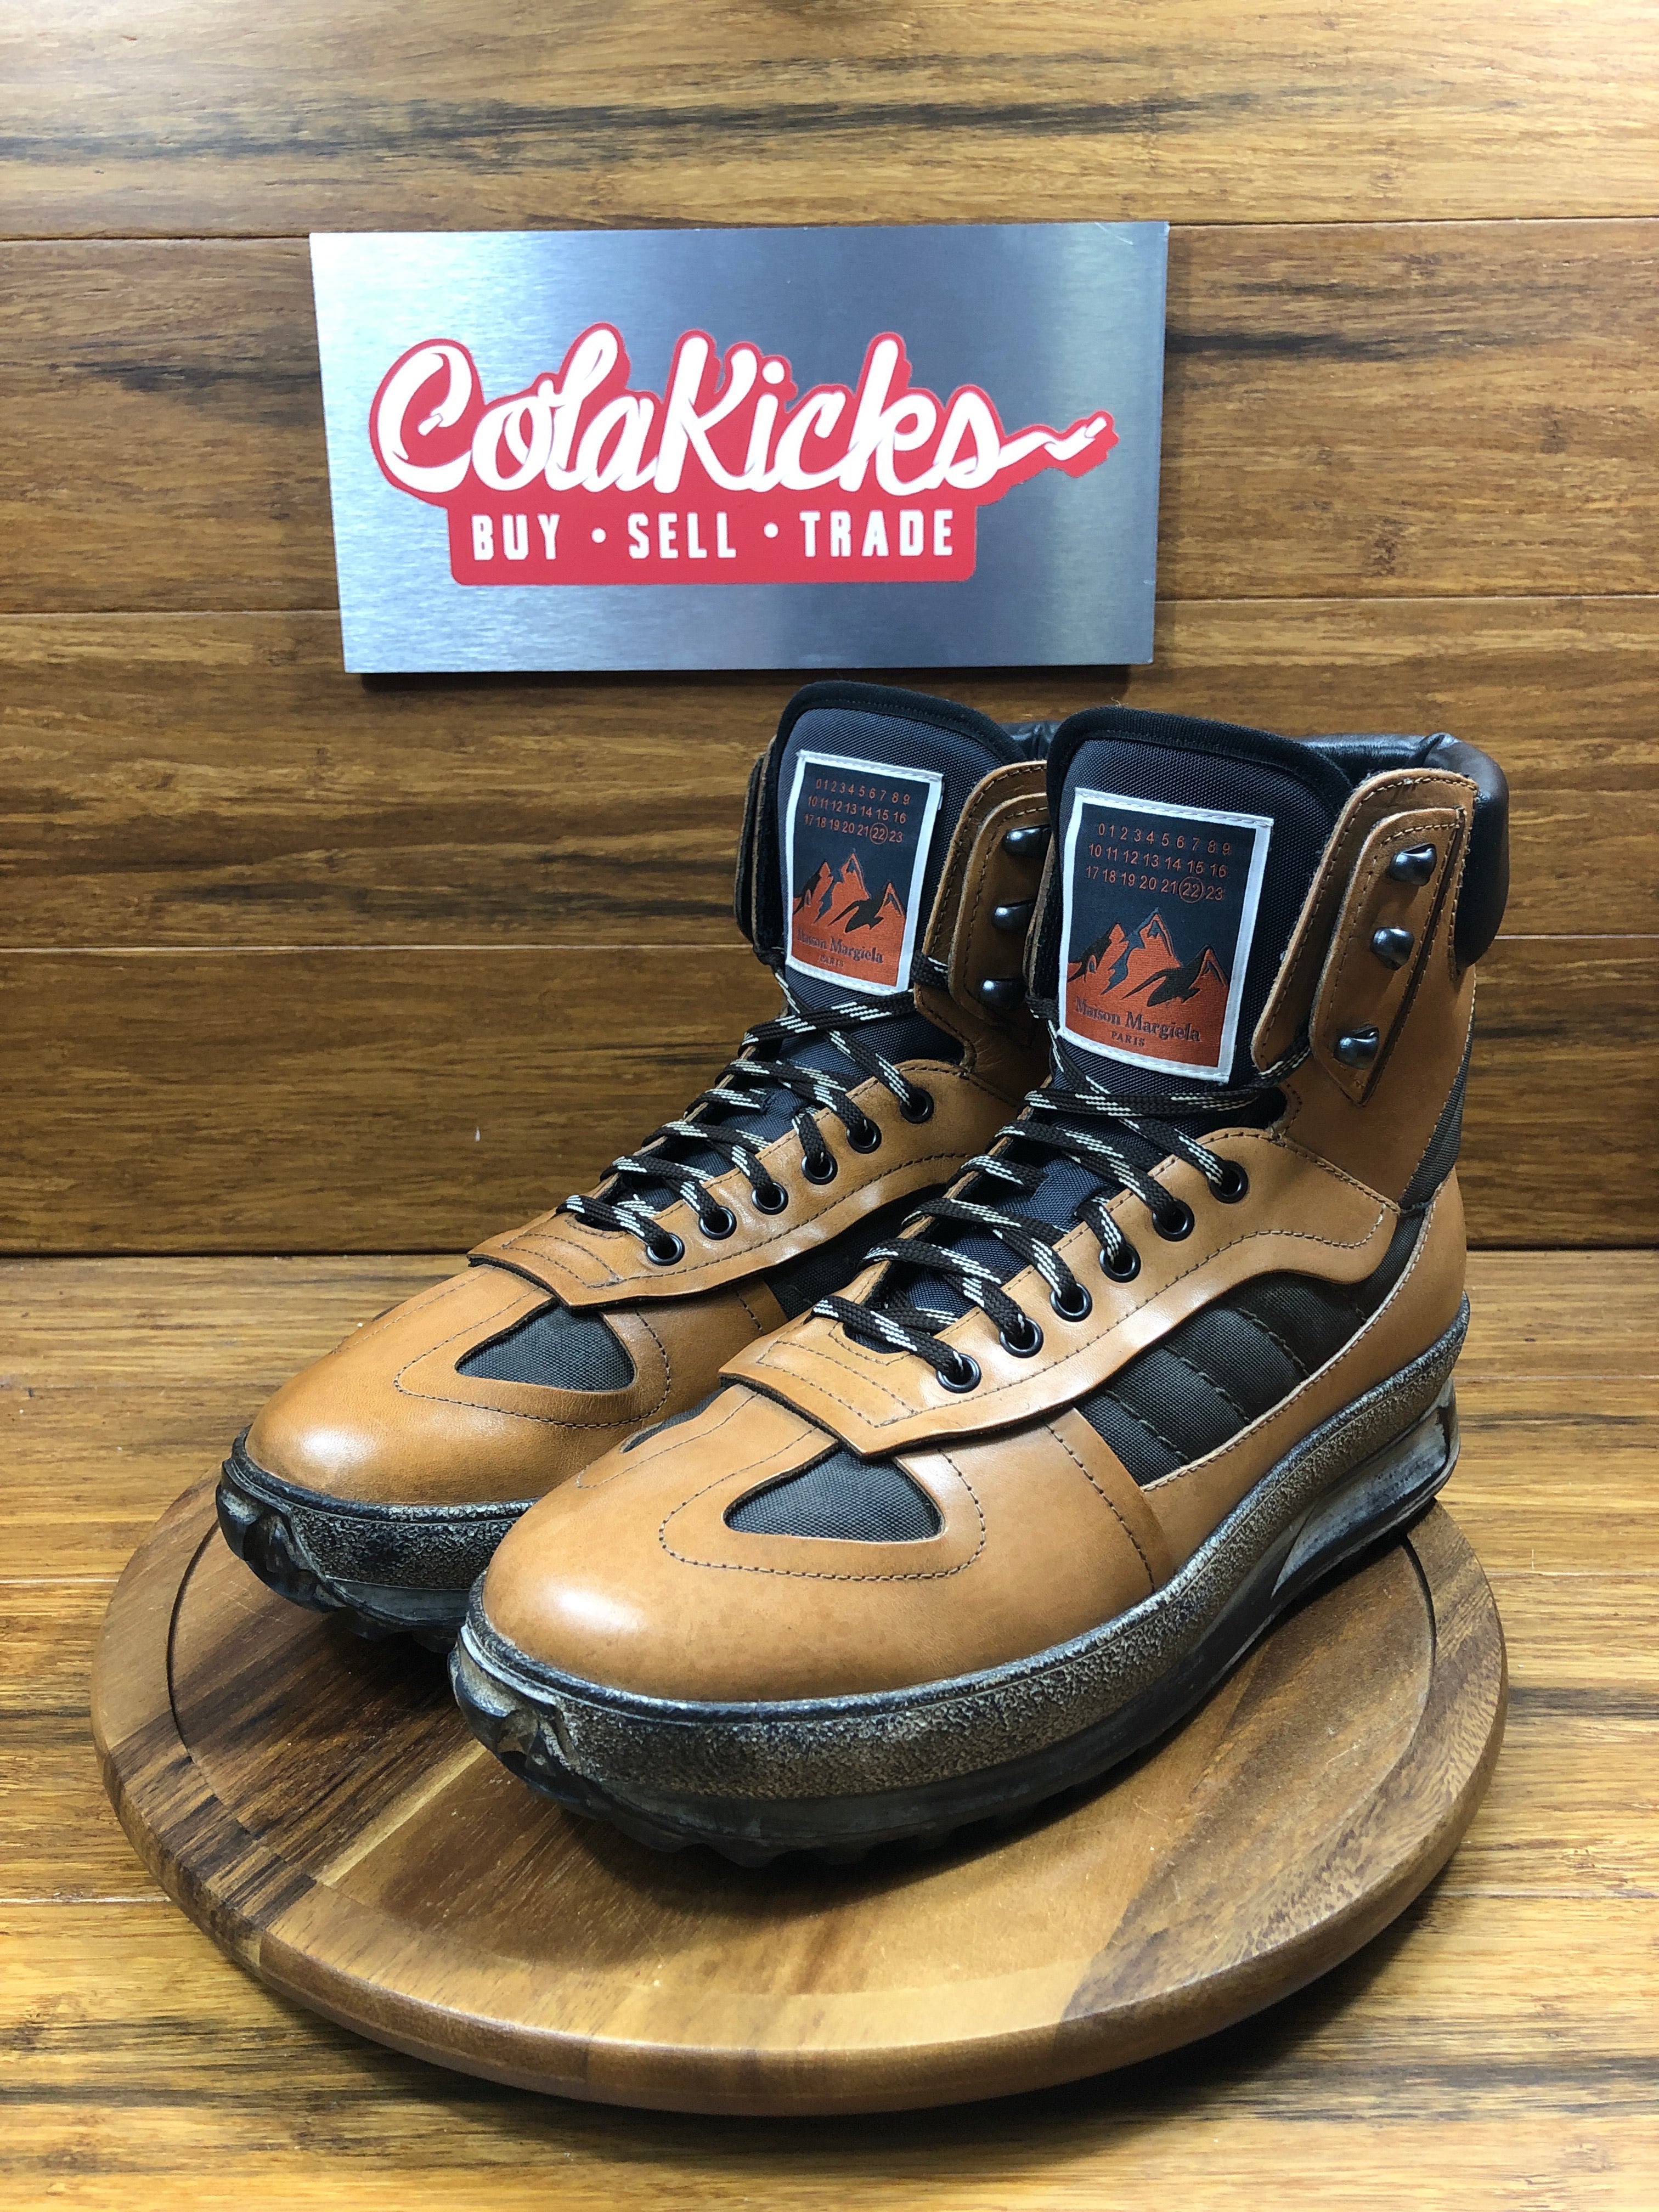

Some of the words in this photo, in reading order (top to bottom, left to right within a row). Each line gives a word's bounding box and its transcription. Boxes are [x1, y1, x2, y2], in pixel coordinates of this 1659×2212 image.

[376, 327, 1109, 497] ColaKicks
[472, 513, 562, 561] BUY
[628, 511, 738, 560] SELL
[800, 510, 955, 557] TRADE
[816, 778, 821, 789] 0
[824, 780, 828, 790] 1
[831, 781, 837, 792] 2
[839, 782, 845, 793] 3
[848, 784, 854, 795] 4
[859, 786, 865, 797] 5
[869, 788, 876, 799] 6
[879, 790, 886, 801] 7
[892, 792, 899, 803] 8
[903, 794, 910, 805] 9
[808, 795, 818, 807] 10
[820, 798, 829, 810] 11
[832, 800, 843, 812] 12
[845, 803, 857, 815] 13
[861, 806, 872, 817] 14
[876, 808, 889, 821] 15
[893, 811, 906, 823] 16
[804, 814, 814, 826] 17
[816, 816, 826, 828] 18
[830, 819, 839, 831] 19
[842, 821, 855, 833] 20
[857, 824, 869, 837] 21
[872, 827, 885, 840] 22
[889, 830, 903, 843] 23
[1098, 823, 1105, 836] 0
[1109, 825, 1115, 838] 1
[1120, 826, 1128, 840] 2
[1133, 828, 1142, 842] 3
[1146, 831, 1154, 844] 4
[1161, 833, 1170, 847] 5
[1177, 836, 1185, 848] 6
[1192, 837, 1200, 850] 7
[1207, 840, 1216, 853] 8
[1222, 843, 1231, 856] 9
[1089, 844, 1102, 857] 10
[1107, 847, 1118, 861] 11
[1123, 850, 1139, 864] 12
[1143, 853, 1159, 867] 13
[1165, 856, 1181, 871] 14
[1187, 860, 1204, 874] 15
[1210, 864, 1227, 878] 16
[1086, 866, 1099, 879] 17
[1103, 869, 1116, 883] 18
[1121, 872, 1135, 887] 19
[1139, 875, 1156, 890] 20
[1161, 879, 1177, 894] 21
[1182, 882, 1200, 898] 22
[1205, 886, 1223, 900] 23
[1075, 996, 1120, 1025] Maison
[1126, 1011, 1200, 1041] Margiela
[1111, 1031, 1145, 1047] PARIS
